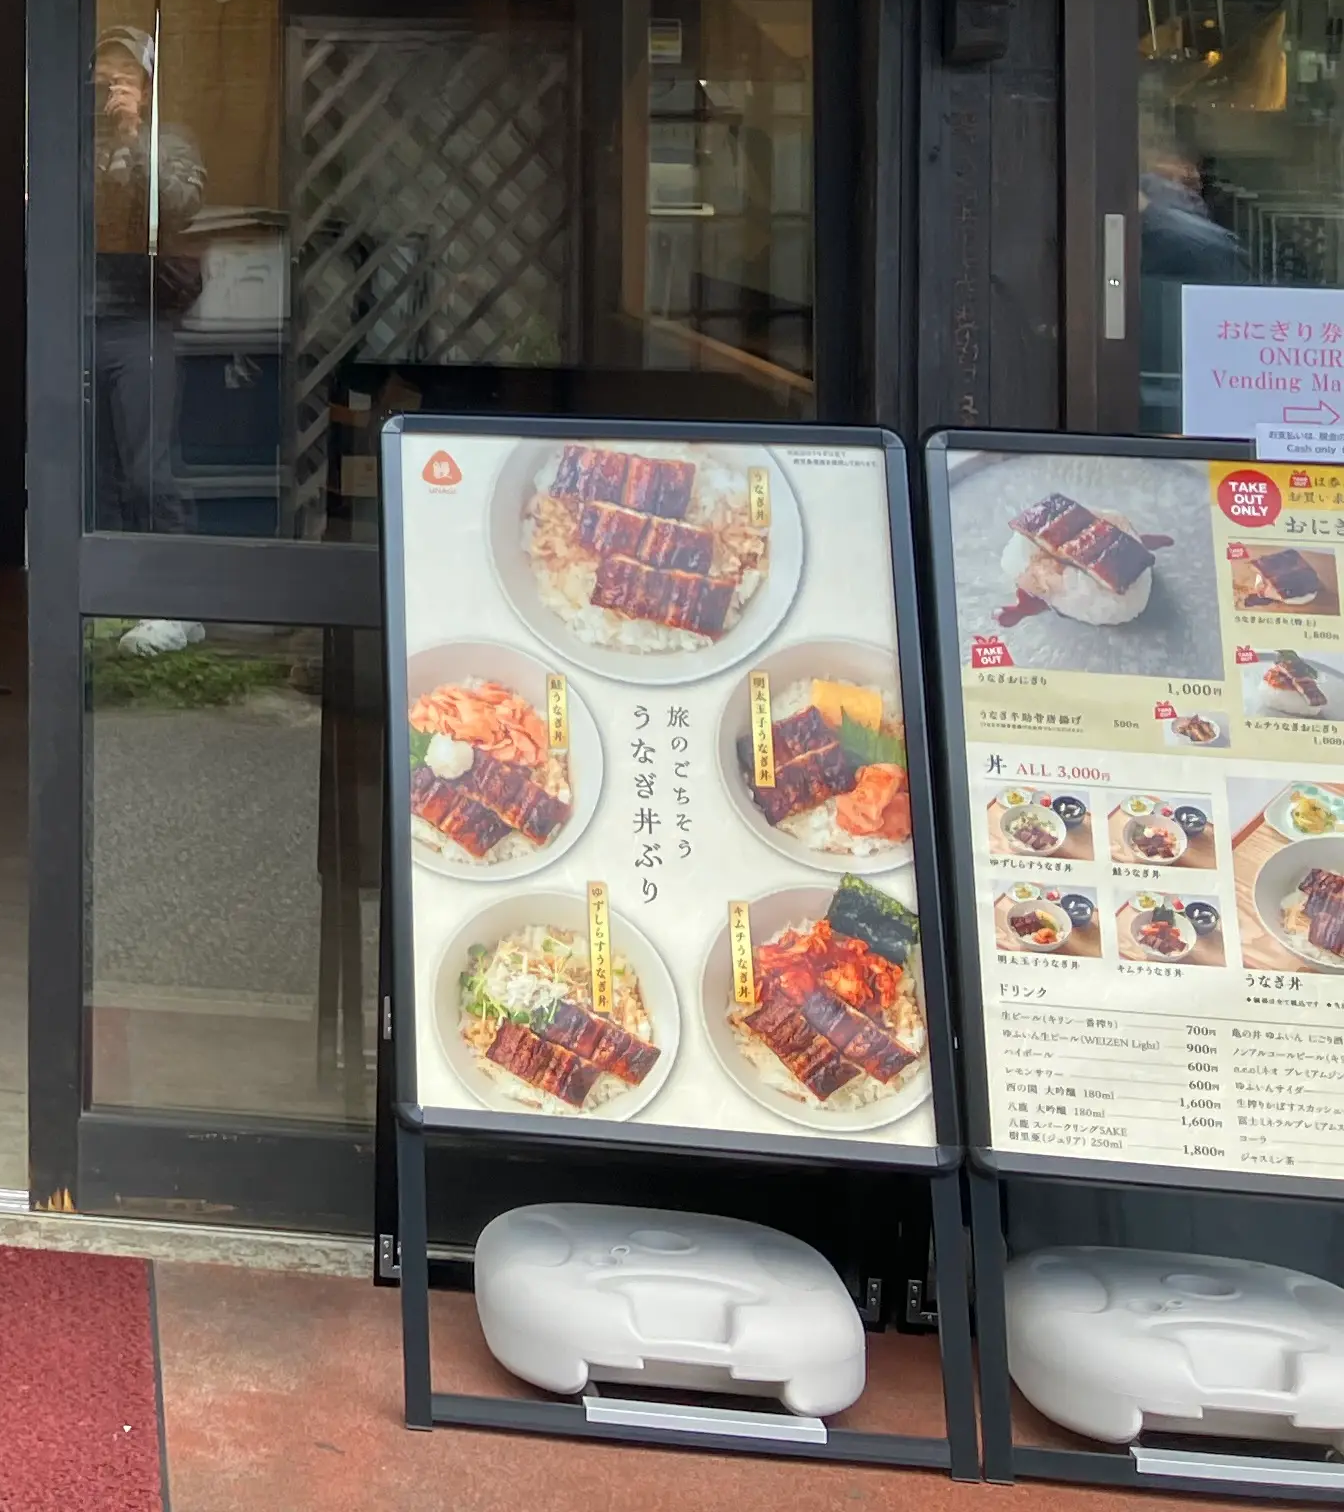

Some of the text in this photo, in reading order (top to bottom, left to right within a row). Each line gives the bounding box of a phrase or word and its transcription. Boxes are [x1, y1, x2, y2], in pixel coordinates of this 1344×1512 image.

[1217, 320, 1343, 343] おにぎり券
[1259, 346, 1343, 368] ONIGIR
[1212, 369, 1341, 393] Vending Ma
[1286, 444, 1312, 453] Cash
[1314, 445, 1336, 454] only
[1228, 481, 1268, 493] TAKE
[1234, 494, 1264, 505] OUT
[1230, 505, 1269, 516] ONLY
[976, 647, 1003, 656] TAKE
[981, 656, 1002, 665] OUT
[978, 672, 1047, 686] うなぎおにぎり
[1168, 683, 1222, 696] 1,000円
[1313, 736, 1344, 745] 1,000
[985, 754, 1111, 781] 丼 ALL 3,000円
[667, 706, 693, 859] 旅のごちそう
[630, 705, 663, 904] うなぎ丼ぶり
[989, 858, 1073, 872] ゆずしらすうなぎ丼
[591, 888, 609, 1007] ゆずしらすうなぎ丼
[733, 906, 751, 998] キムチうなぎ丼
[1117, 964, 1184, 978] キムチうなぎ丼
[1245, 973, 1303, 991] うなぎ丼
[999, 982, 1047, 998] ドリンク
[1186, 1025, 1216, 1036] 700円
[1186, 1043, 1217, 1055] 900円
[1005, 1067, 1064, 1078] レモンサワー
[1187, 1062, 1218, 1073] 600円
[1188, 1080, 1220, 1091] 600円
[1083, 1089, 1114, 1100] 180ml
[1179, 1098, 1221, 1109] 1,600円
[1236, 1098, 1344, 1114] 生搾りかぼすスカッシュ
[1074, 1107, 1105, 1118] 180ml
[1181, 1116, 1223, 1128] 1,600円
[1091, 1138, 1123, 1149] 250ml
[1183, 1144, 1225, 1157] 1,800円
